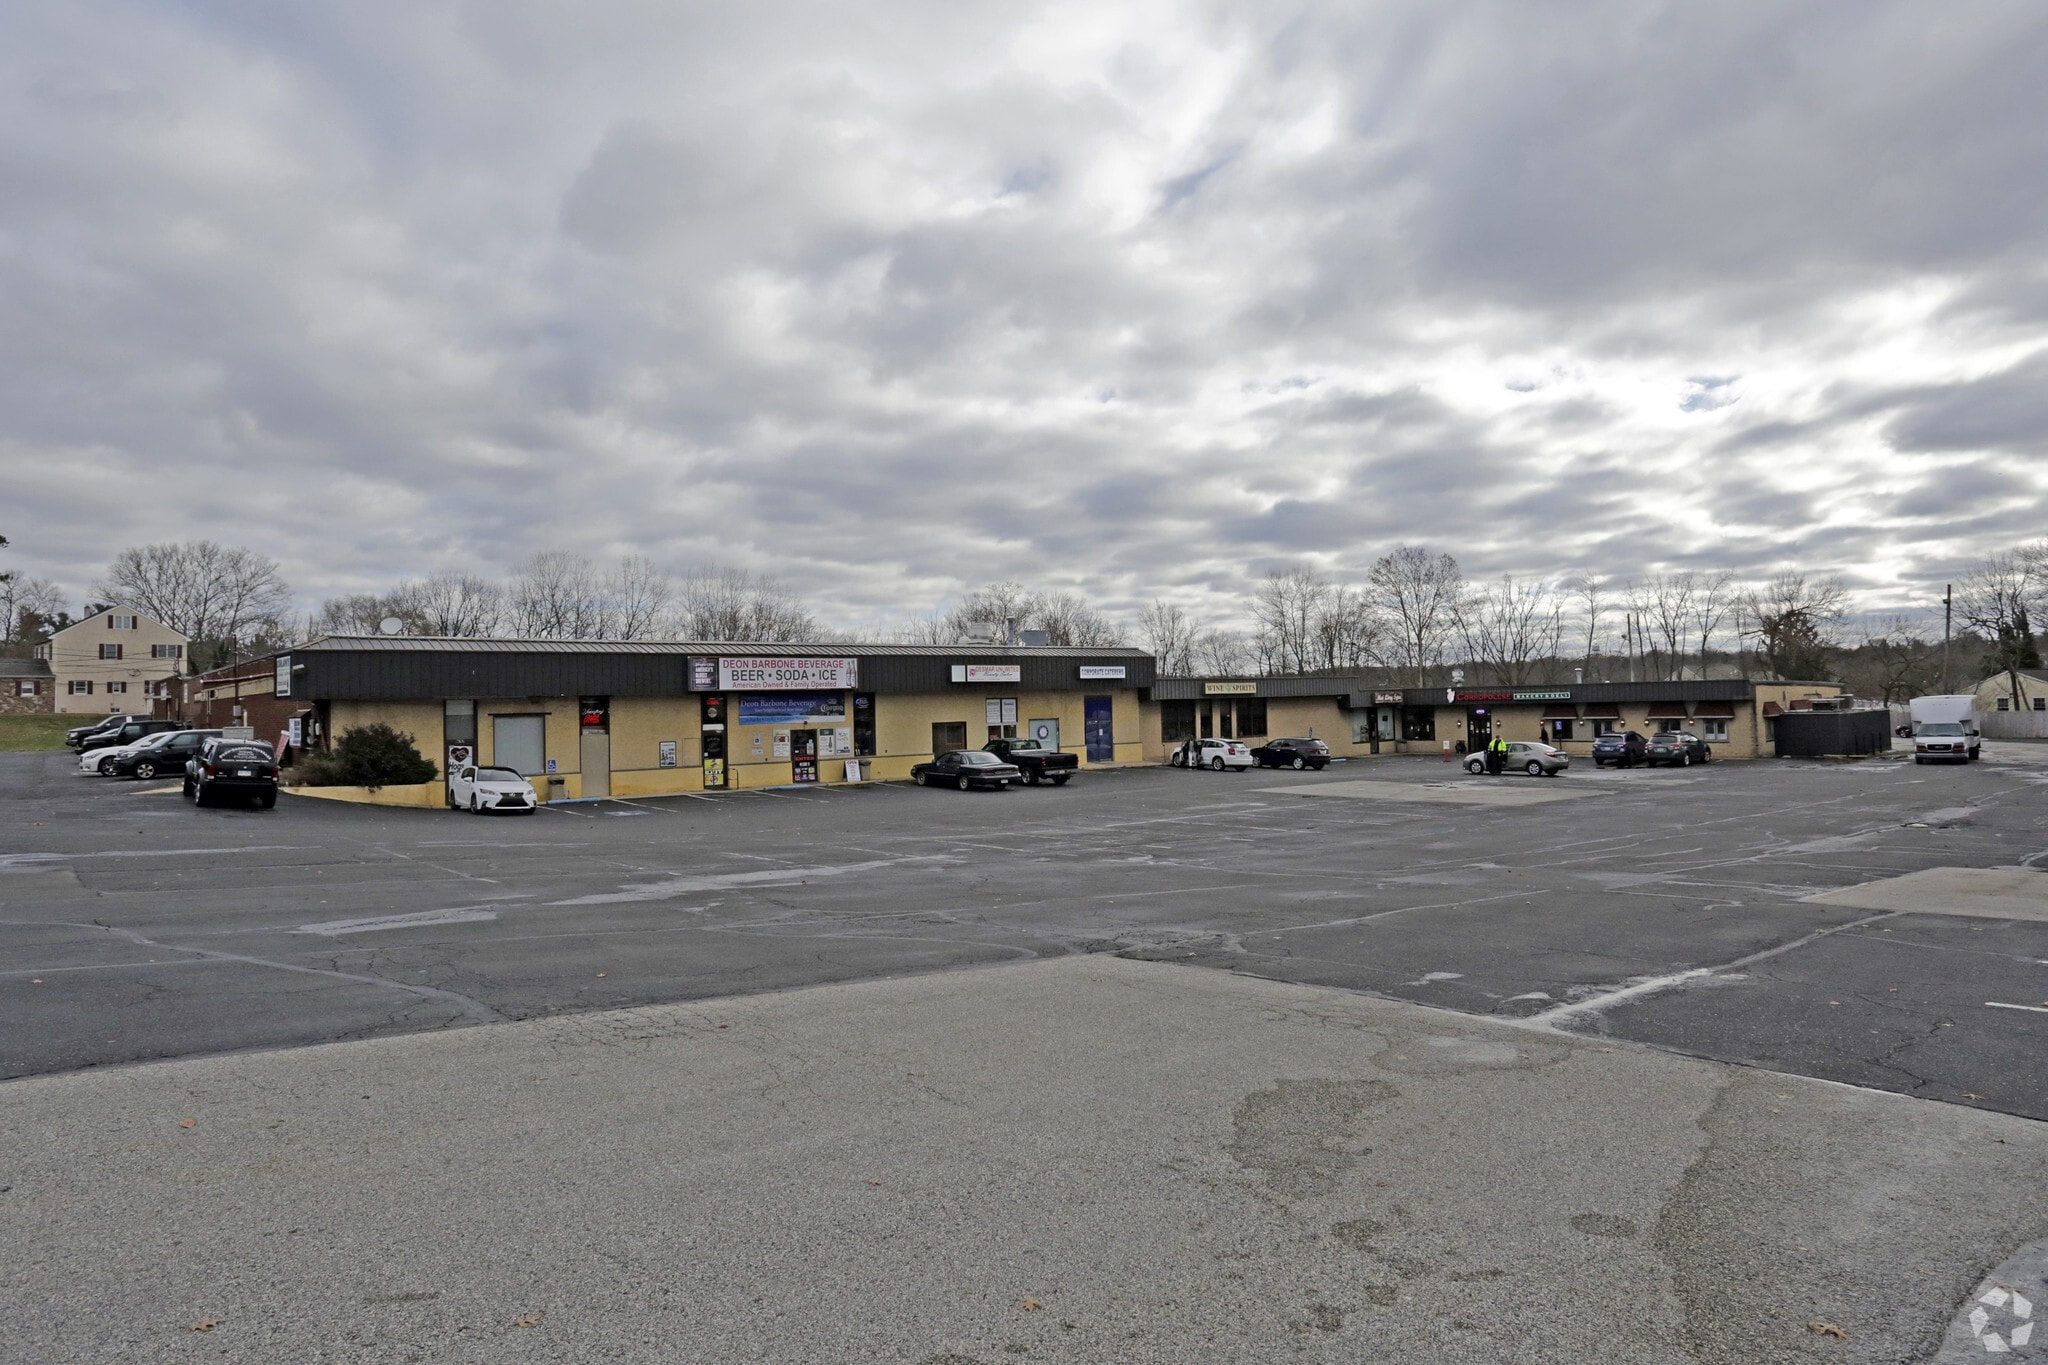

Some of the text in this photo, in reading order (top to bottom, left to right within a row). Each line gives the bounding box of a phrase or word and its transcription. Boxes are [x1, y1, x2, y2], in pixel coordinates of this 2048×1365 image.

[722, 660, 749, 669] DEON
[752, 660, 795, 669] BARBONE
[798, 660, 844, 669] BEVERAGE
[732, 669, 837, 681] BEER SODA ICE
[791, 681, 810, 689] Family
[811, 681, 837, 689] Operated
[788, 700, 817, 709] Beverage
